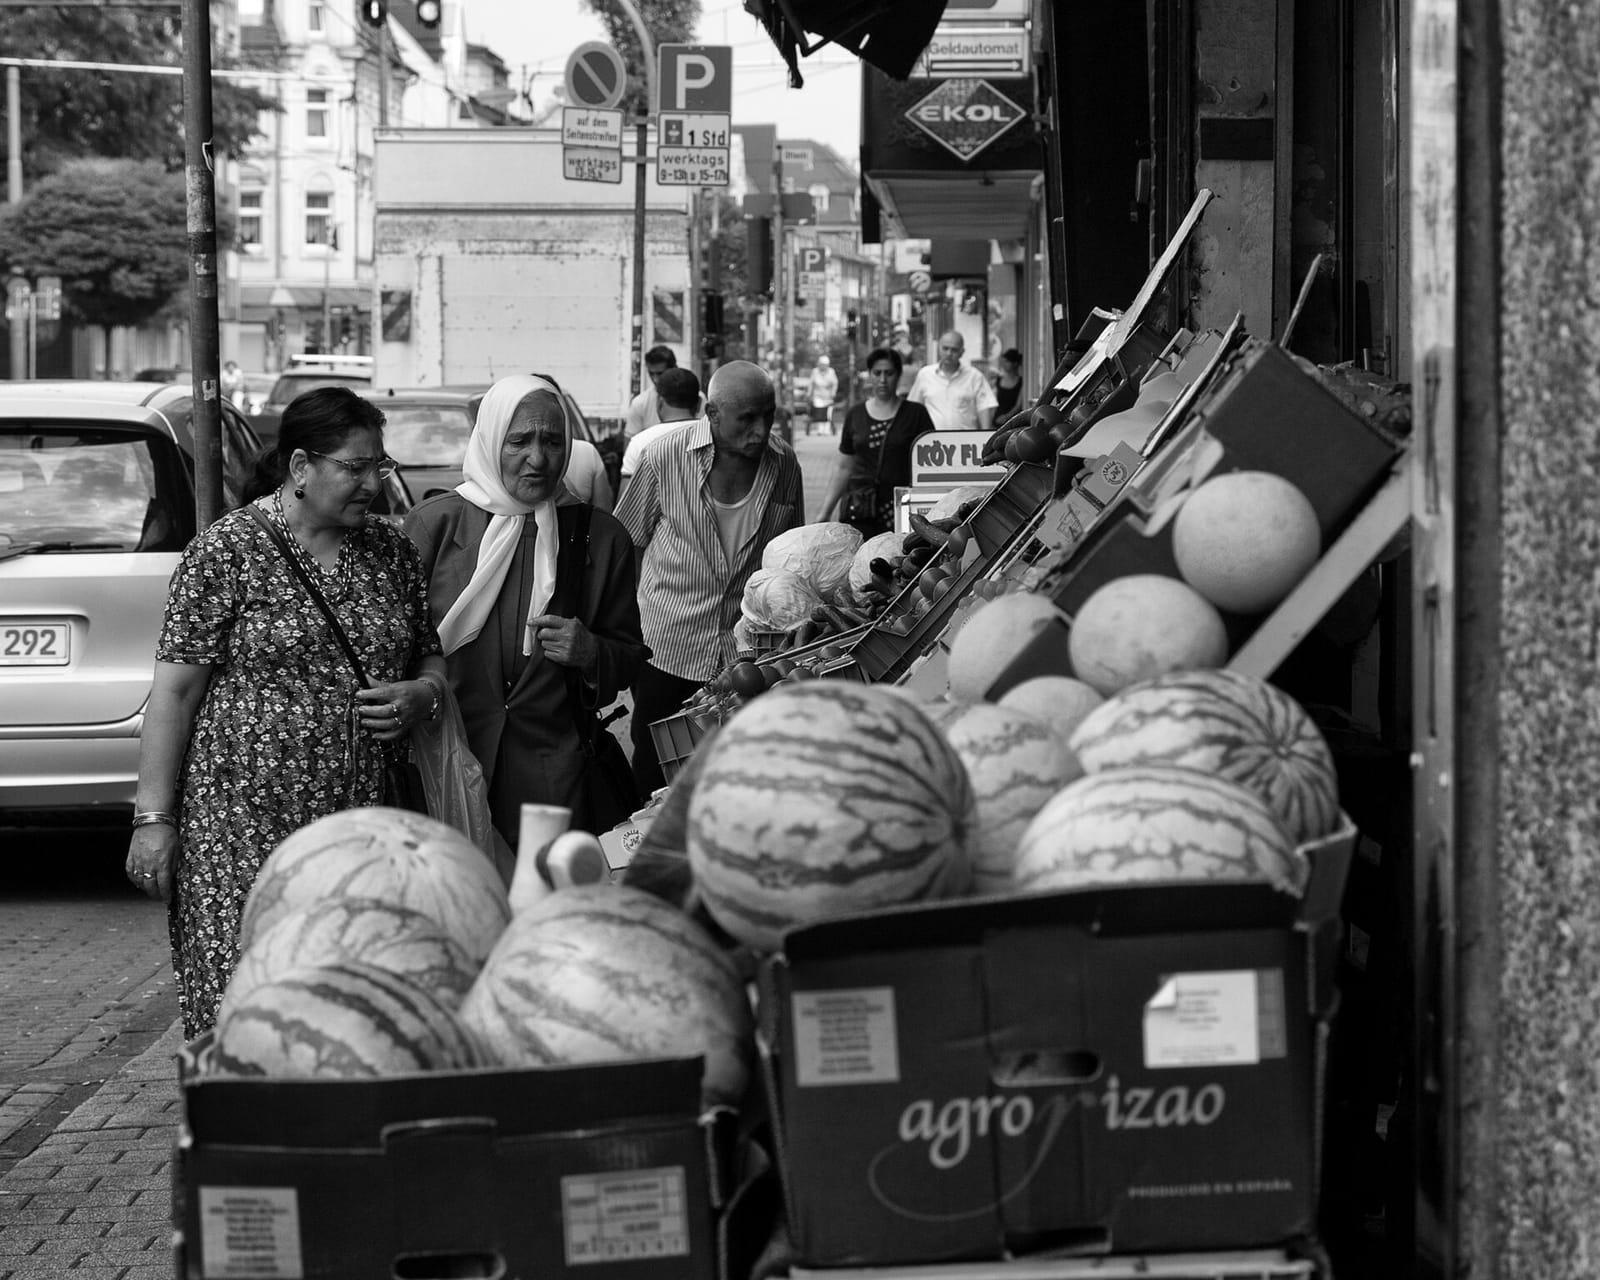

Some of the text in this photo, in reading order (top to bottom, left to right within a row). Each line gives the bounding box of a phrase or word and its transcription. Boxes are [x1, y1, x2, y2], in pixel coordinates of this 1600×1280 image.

[929, 42, 1019, 55] Geldautomat
[676, 54, 715, 109] P
[916, 104, 1011, 122] EKOL
[577, 116, 608, 127] auf dem
[566, 128, 618, 142] Seitenstreifen
[688, 129, 726, 146] 1 Std
[568, 156, 617, 172] werktags
[662, 153, 725, 168] werktags
[805, 250, 821, 270] P
[917, 440, 957, 467] KÖY
[4, 629, 56, 656] 292
[1213, 1181, 1234, 1195] EN
